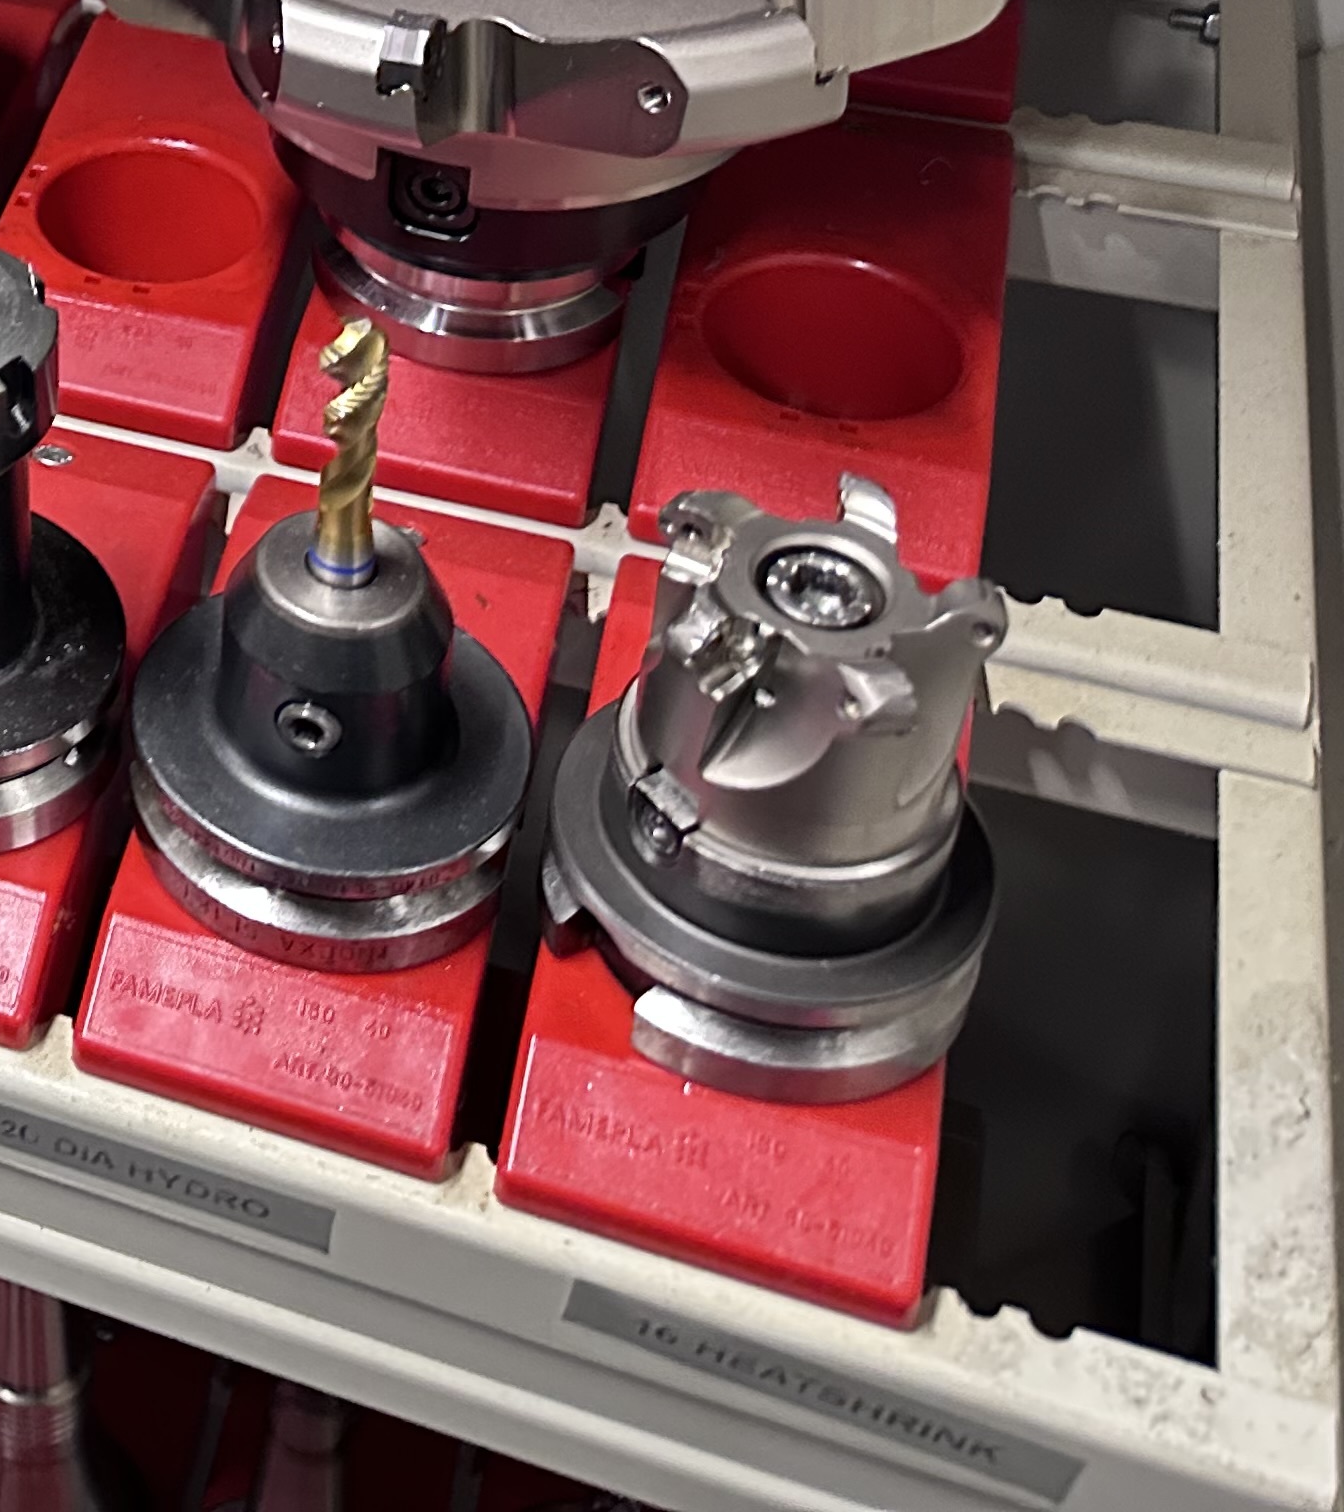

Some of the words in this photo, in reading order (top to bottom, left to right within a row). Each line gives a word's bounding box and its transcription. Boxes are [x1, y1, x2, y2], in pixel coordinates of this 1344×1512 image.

[53, 1134, 115, 1168] DIA
[128, 1160, 272, 1220] HYDRO
[634, 1317, 678, 1346] 16
[694, 1329, 1003, 1463] HEATSHRINK
